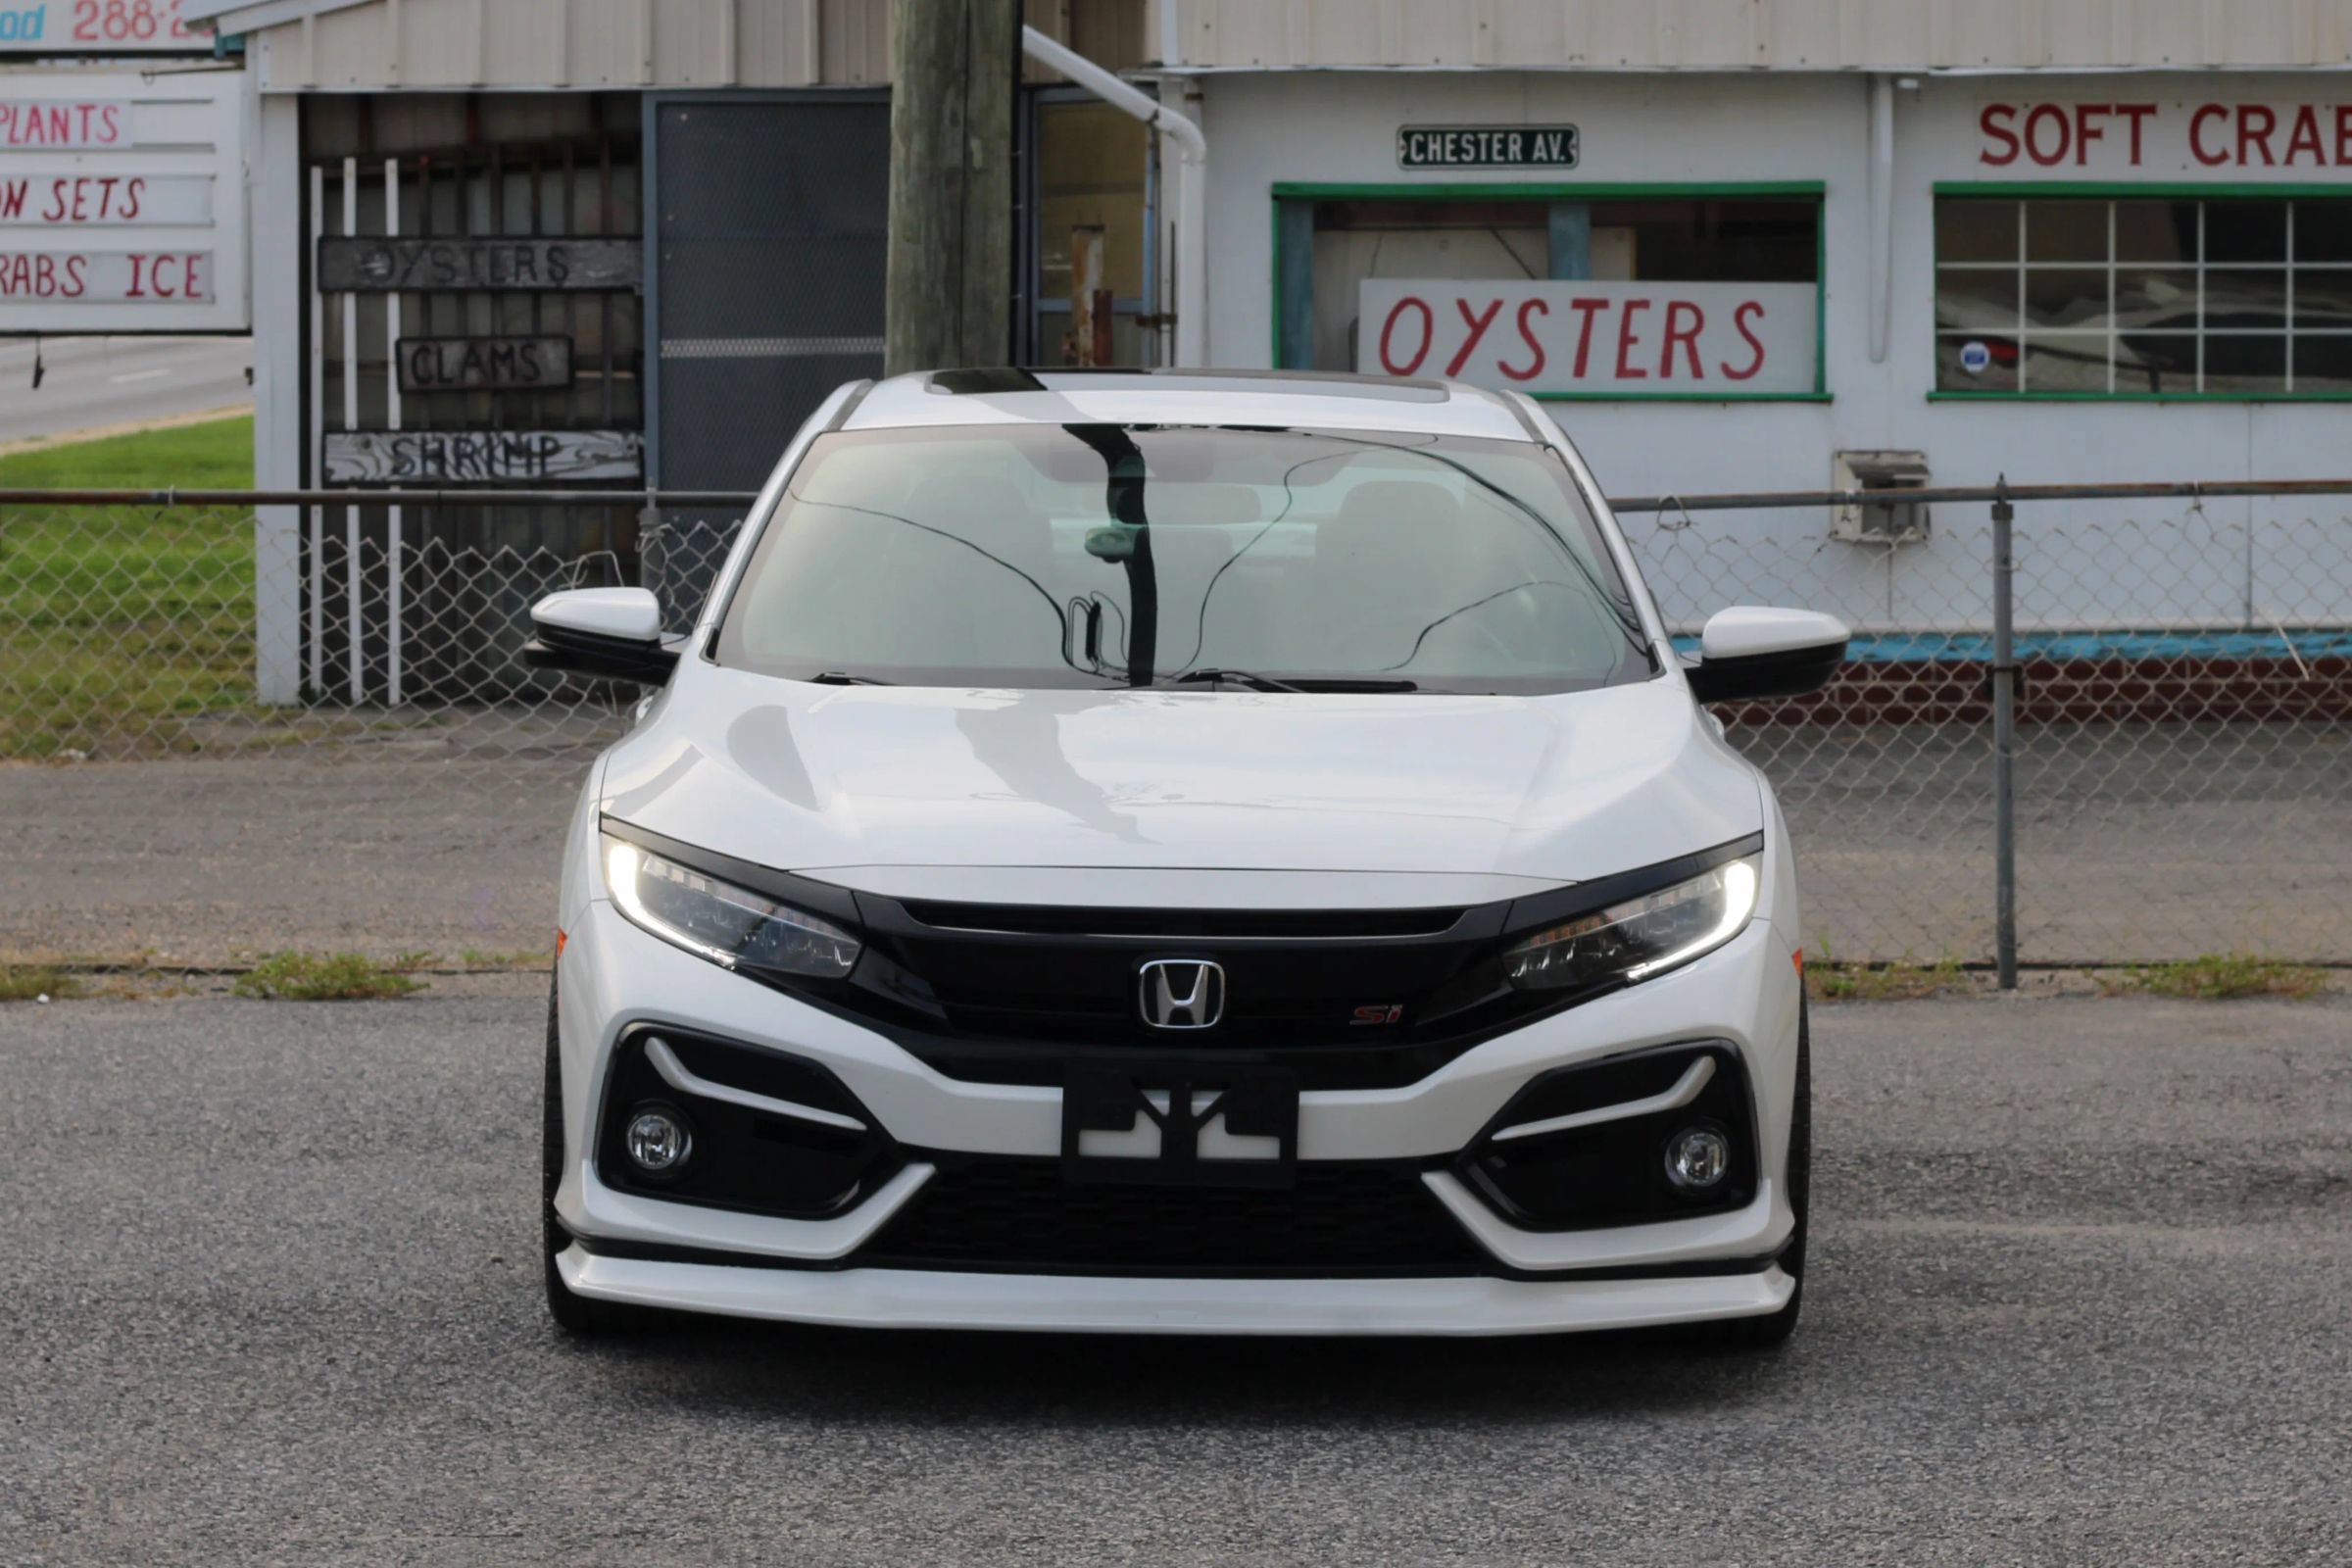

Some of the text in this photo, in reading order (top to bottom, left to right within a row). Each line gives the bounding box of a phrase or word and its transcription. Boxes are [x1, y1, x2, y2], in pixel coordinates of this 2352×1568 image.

[1409, 132, 1566, 163] CHESTER AV.
[1979, 103, 2157, 166] SOFT
[43, 177, 145, 221] SETS
[125, 254, 203, 298] ICE
[360, 247, 568, 284] OYSTERS
[1379, 297, 1765, 381] OYSTERS
[411, 344, 541, 383] CLAMS
[391, 435, 562, 476] SHRIMP
